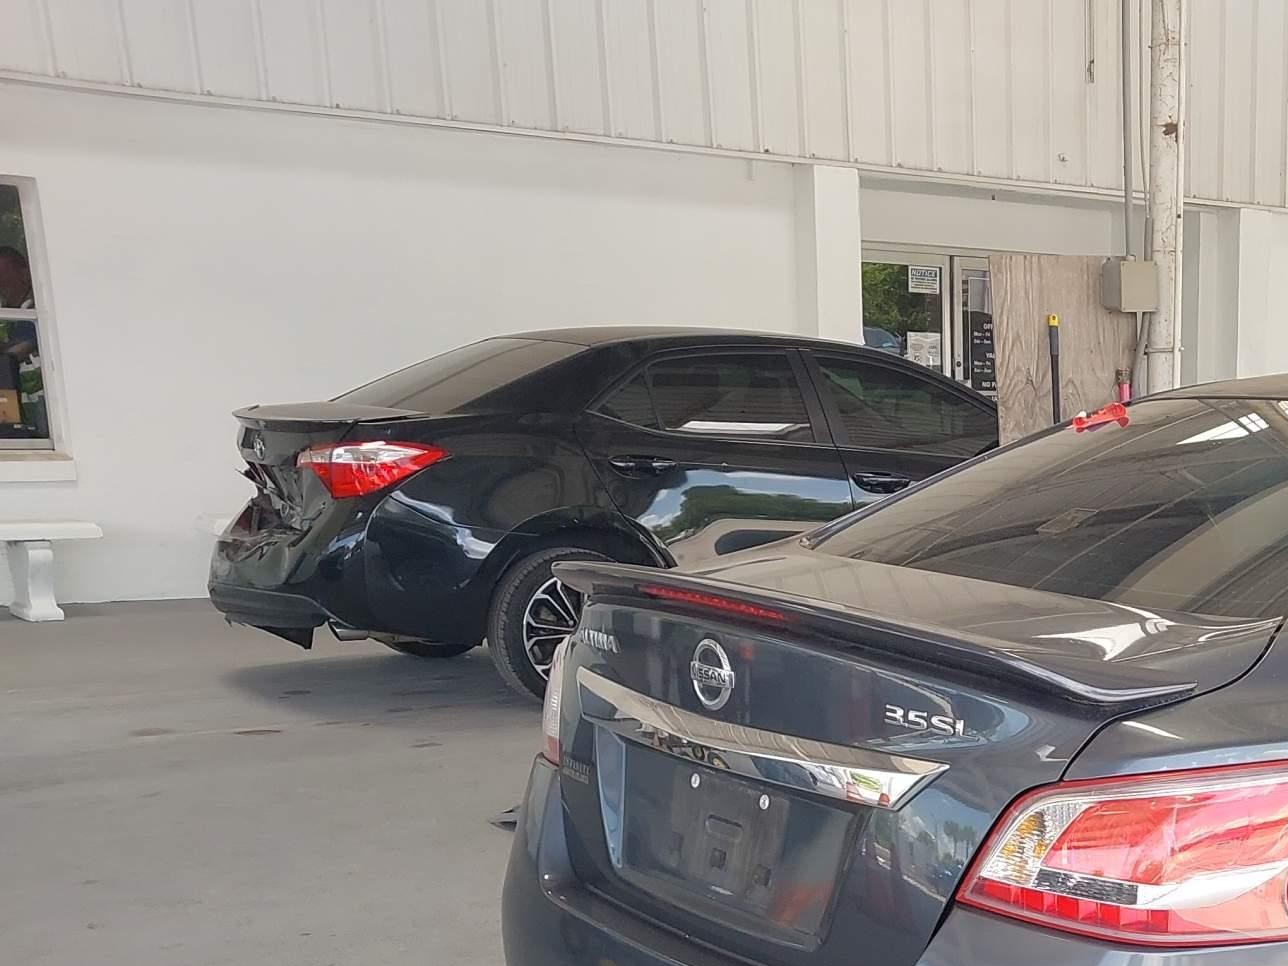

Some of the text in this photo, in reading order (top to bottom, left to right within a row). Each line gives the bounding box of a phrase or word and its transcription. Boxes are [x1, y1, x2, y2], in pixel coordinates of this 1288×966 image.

[911, 269, 936, 277] NOTICE
[579, 627, 621, 654] ALTIMA
[691, 662, 728, 685] NISSAN
